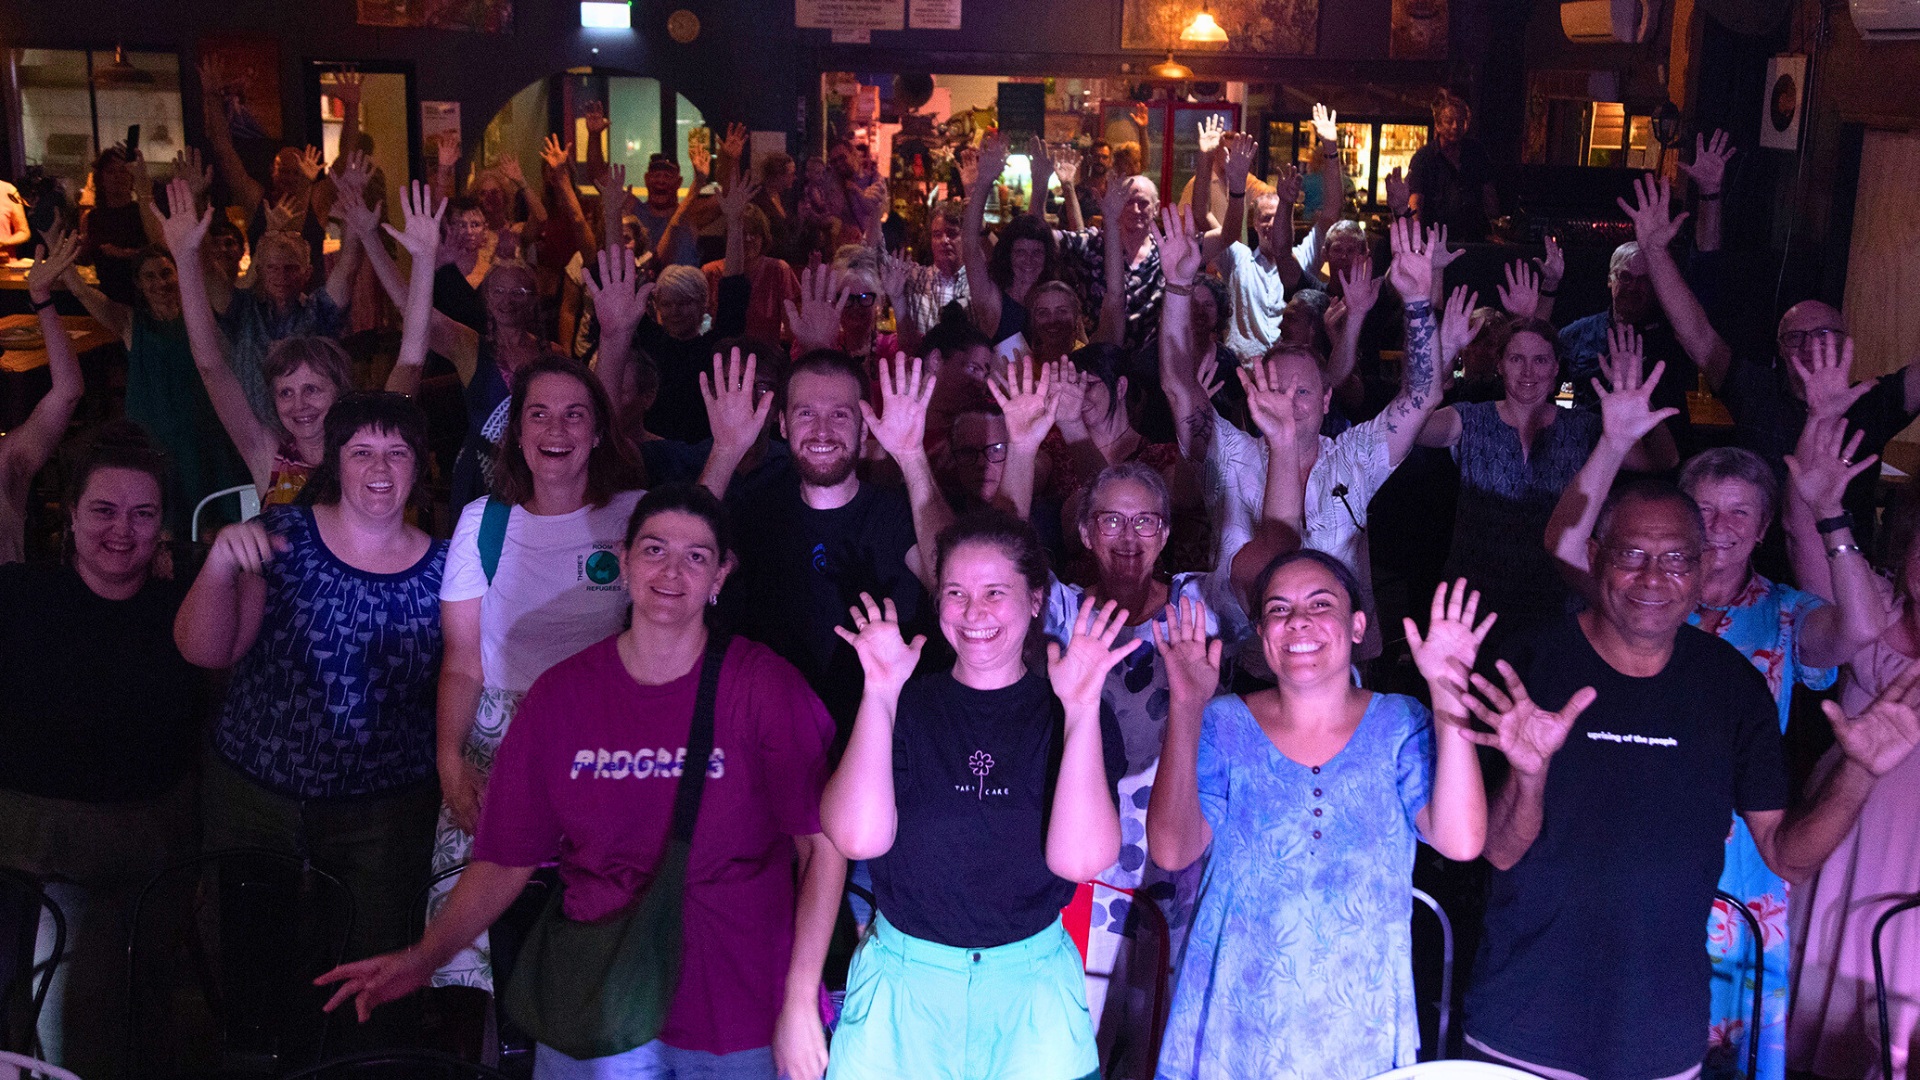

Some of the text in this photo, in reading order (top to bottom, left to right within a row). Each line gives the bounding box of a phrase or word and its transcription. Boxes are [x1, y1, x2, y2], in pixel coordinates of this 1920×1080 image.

[1586, 731, 1678, 747] uprising of the people
[569, 748, 725, 780] PROGRES
[985, 787, 1010, 796] CARE
